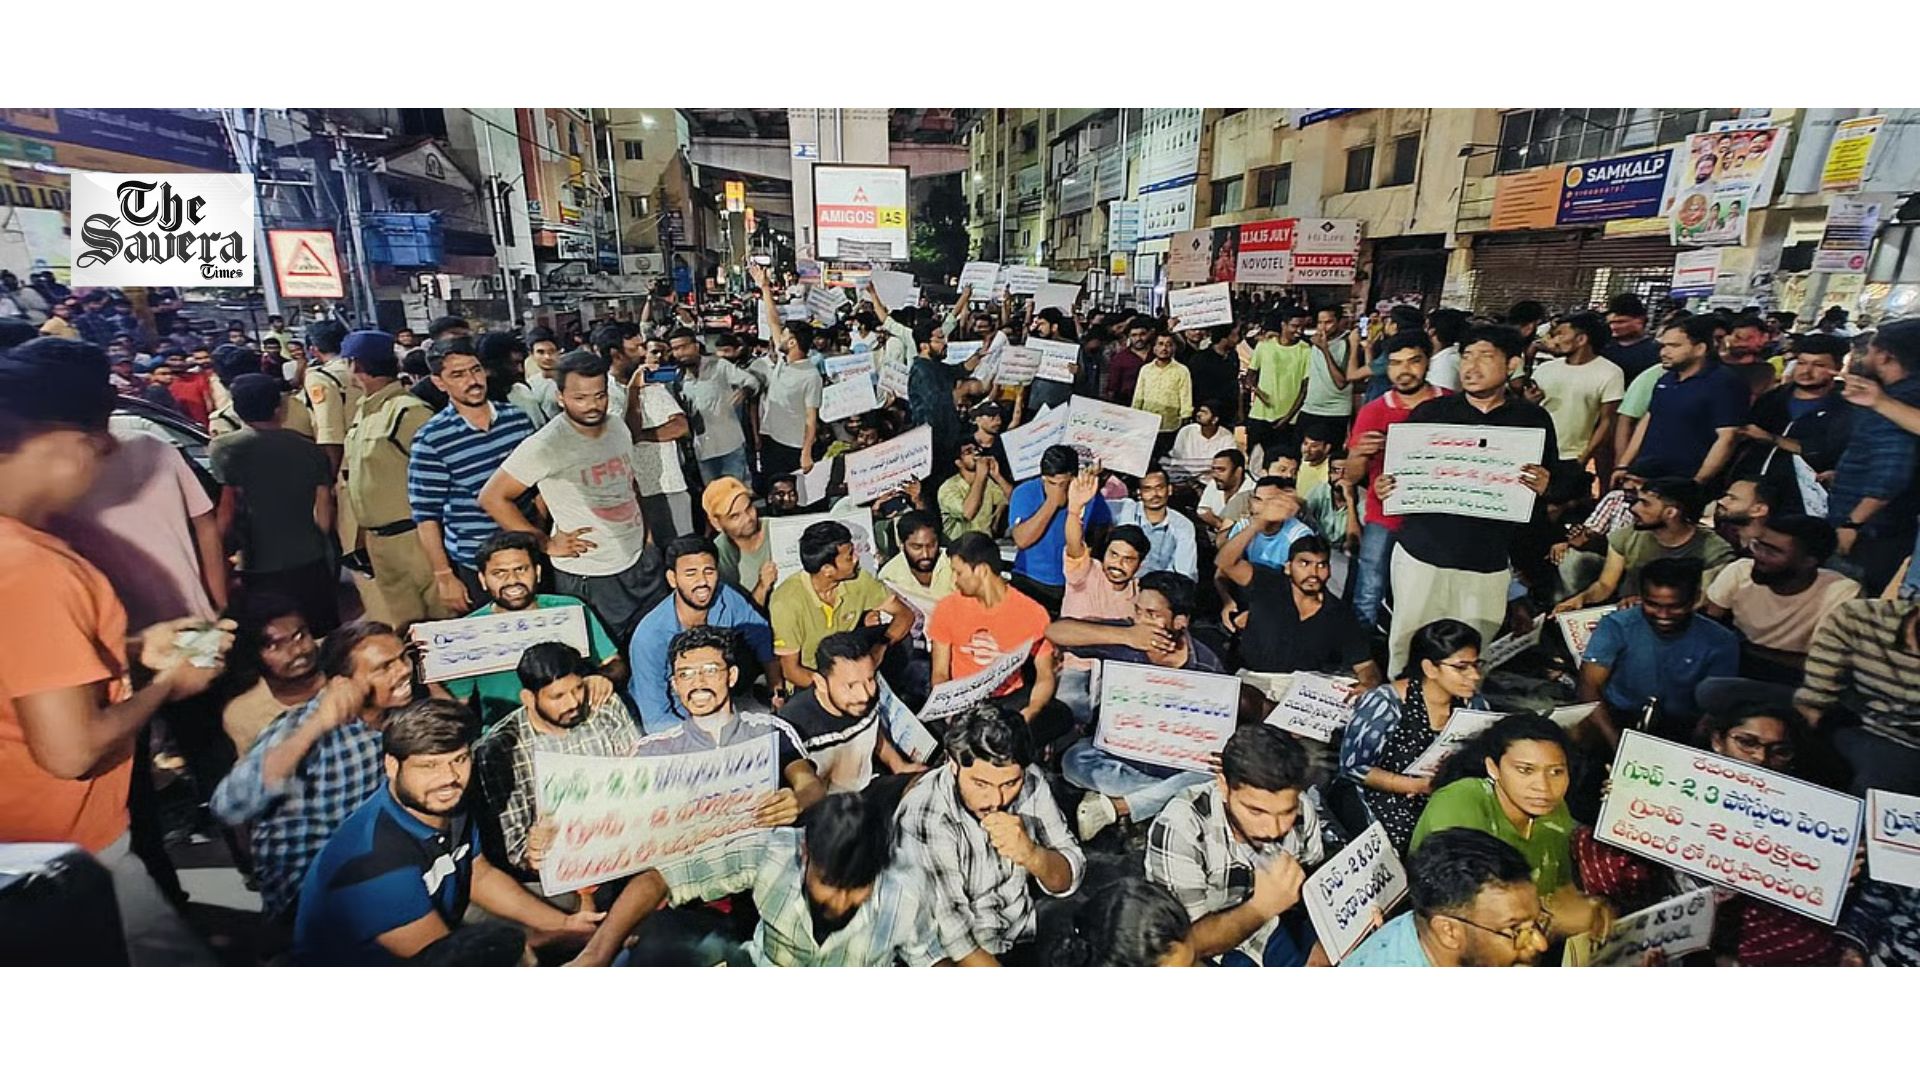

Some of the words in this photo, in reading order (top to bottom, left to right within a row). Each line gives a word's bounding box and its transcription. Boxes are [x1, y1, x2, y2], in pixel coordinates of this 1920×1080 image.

[1586, 158, 1665, 183] SAMKALP
[820, 208, 875, 225] AMIGOS
[1269, 227, 1291, 242] JULY
[1241, 256, 1284, 270] NOVOTEL
[1328, 256, 1352, 266] JULY
[1299, 268, 1346, 278] NOVOTEL
[1706, 822, 1728, 841] 2
